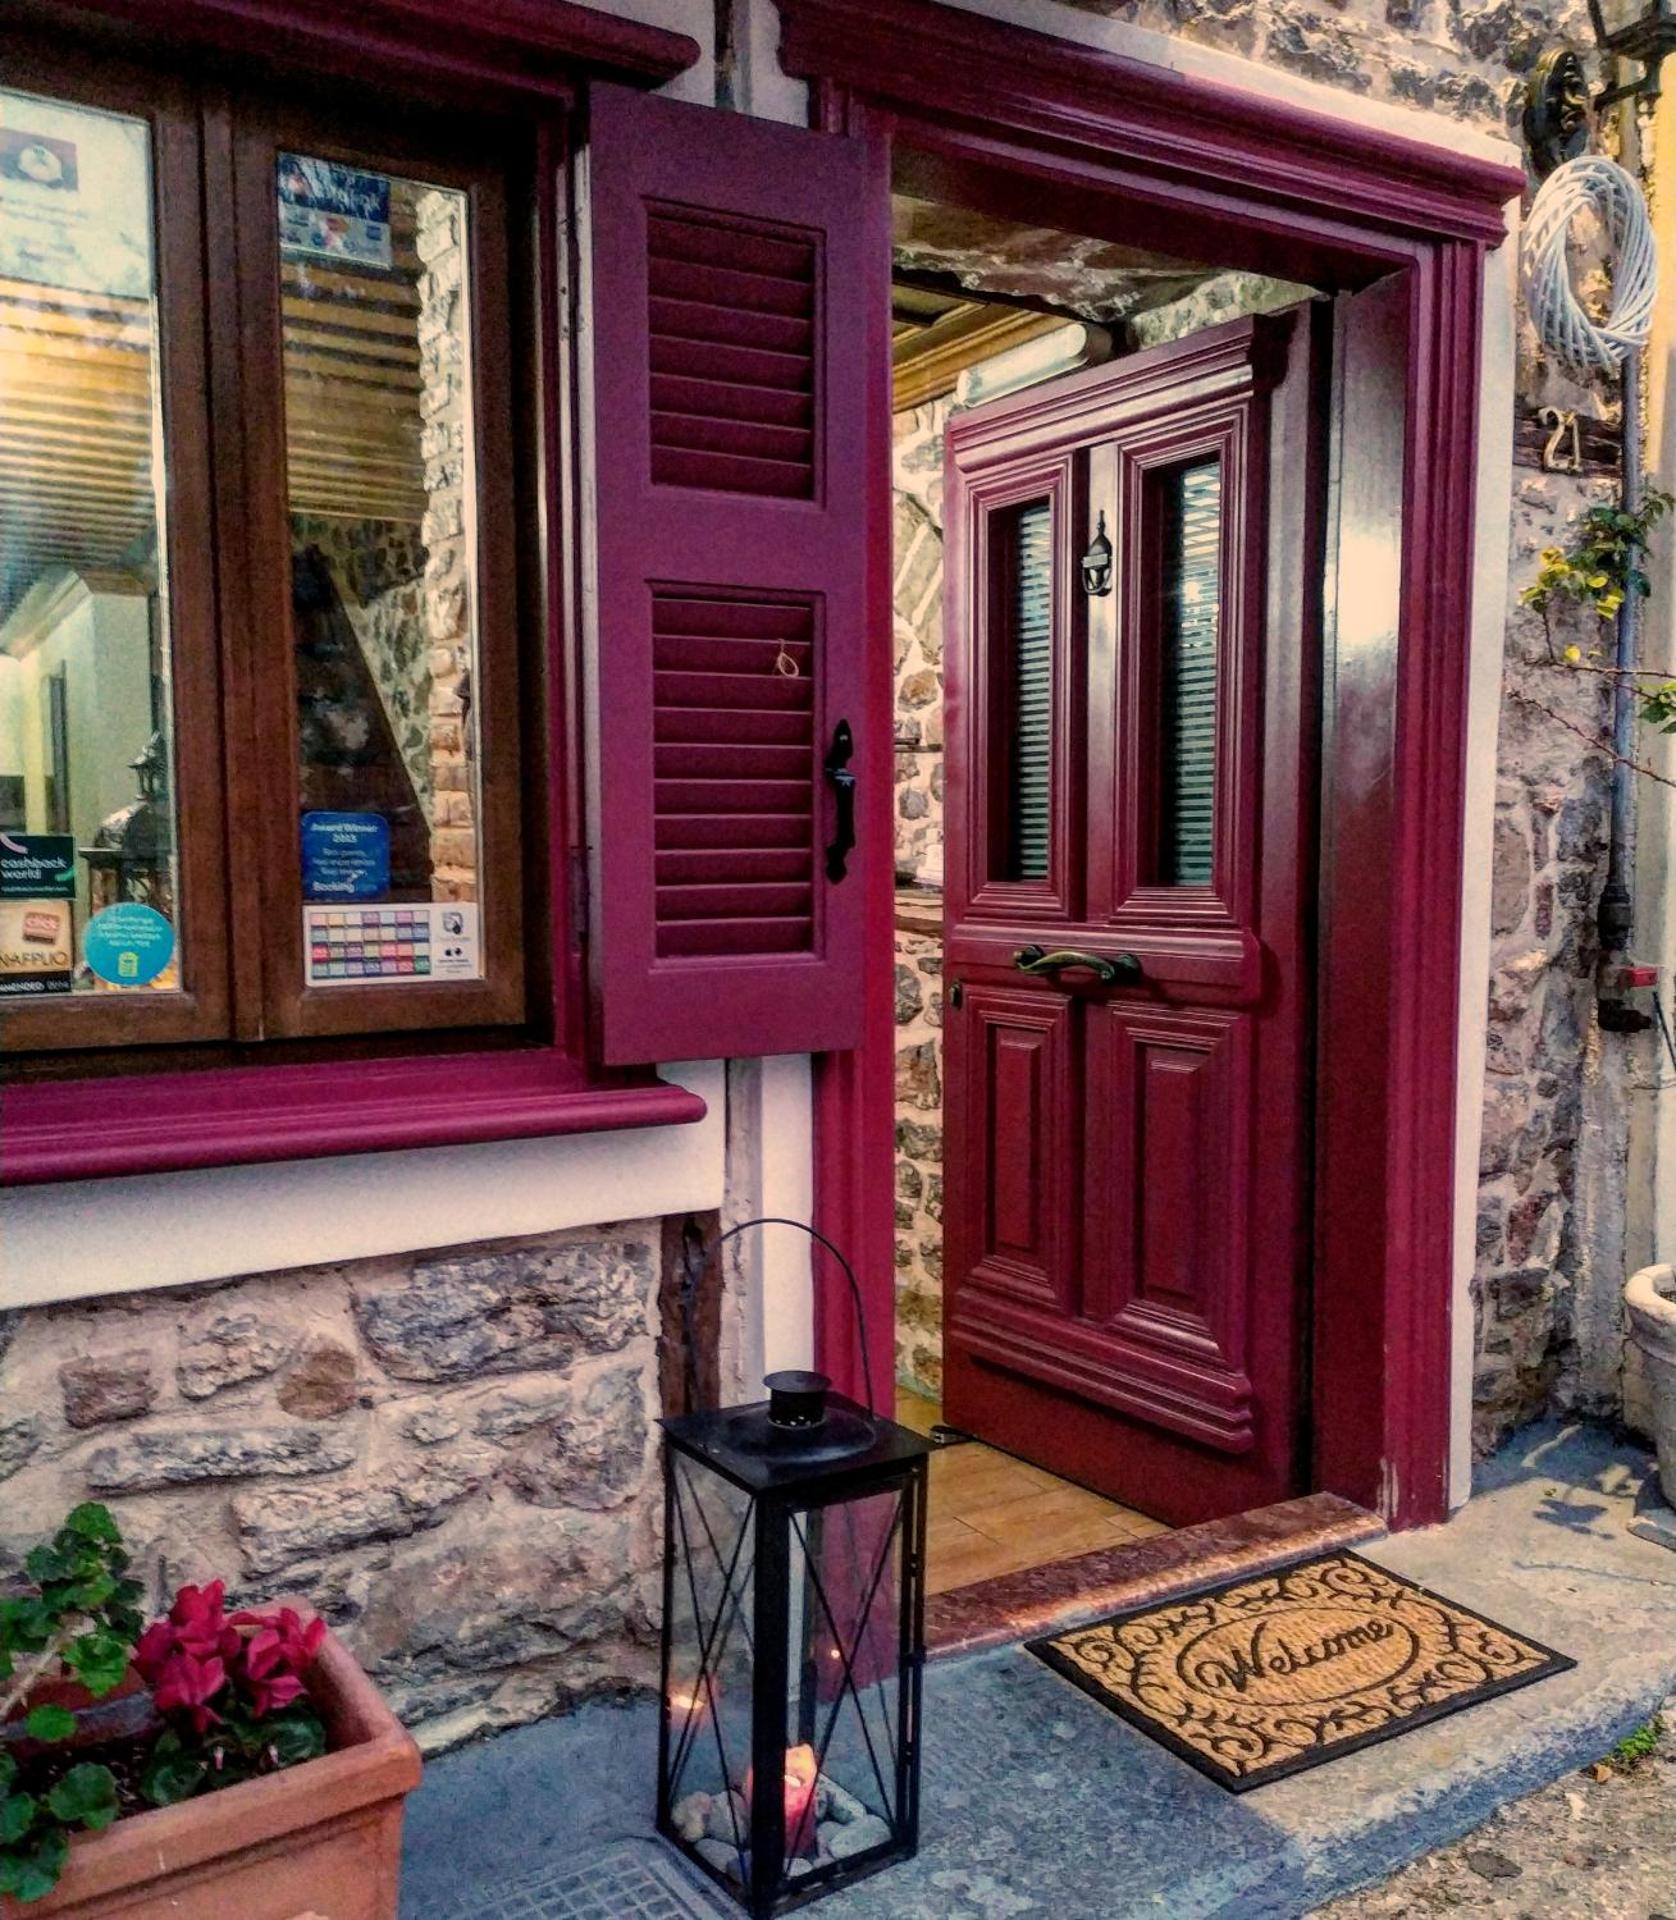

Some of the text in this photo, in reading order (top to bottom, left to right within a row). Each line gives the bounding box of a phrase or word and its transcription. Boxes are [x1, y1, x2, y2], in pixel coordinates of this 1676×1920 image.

[1, 857, 68, 869] cashback
[1, 869, 42, 880] world
[1194, 1617, 1395, 1692] Welcome
